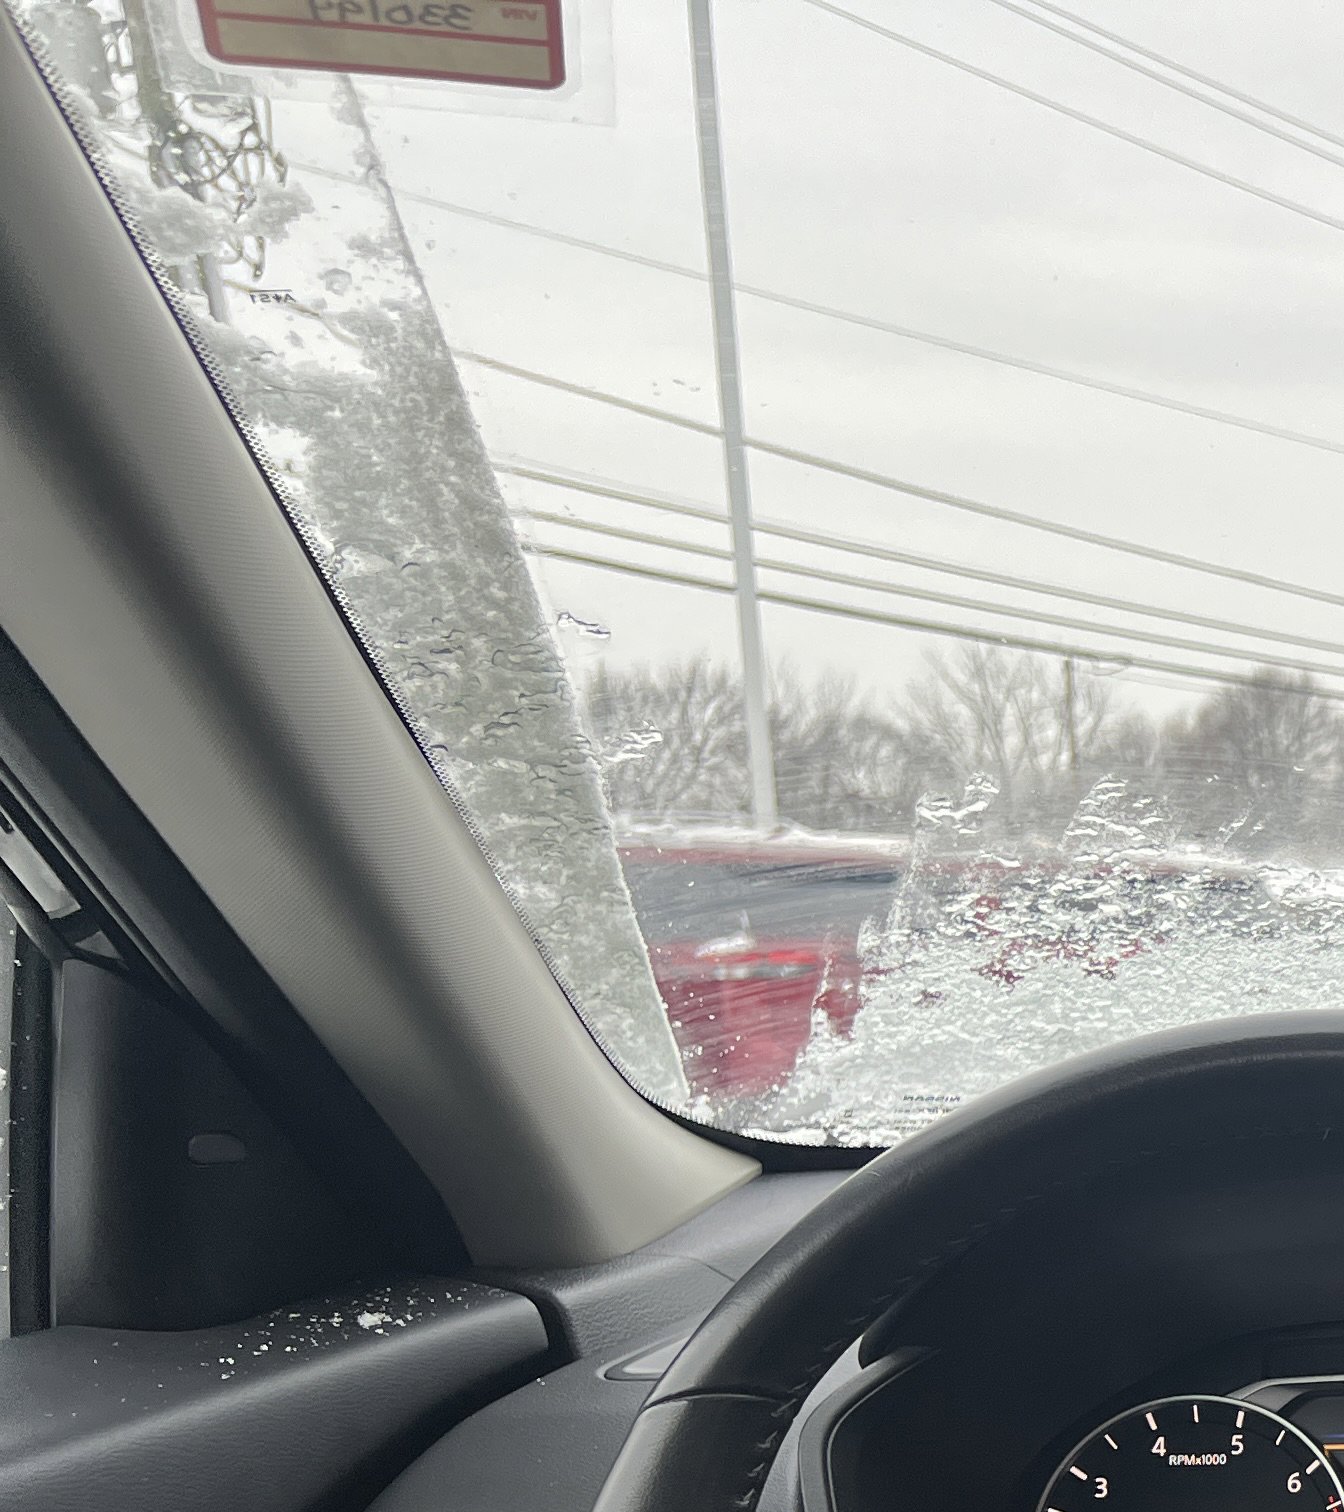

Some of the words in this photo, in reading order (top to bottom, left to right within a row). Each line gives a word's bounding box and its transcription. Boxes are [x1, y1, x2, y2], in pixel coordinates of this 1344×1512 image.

[1152, 1436, 1166, 1457] 4
[1231, 1434, 1244, 1456] 5
[1094, 1477, 1108, 1499] 3
[1287, 1472, 1302, 1494] 6
